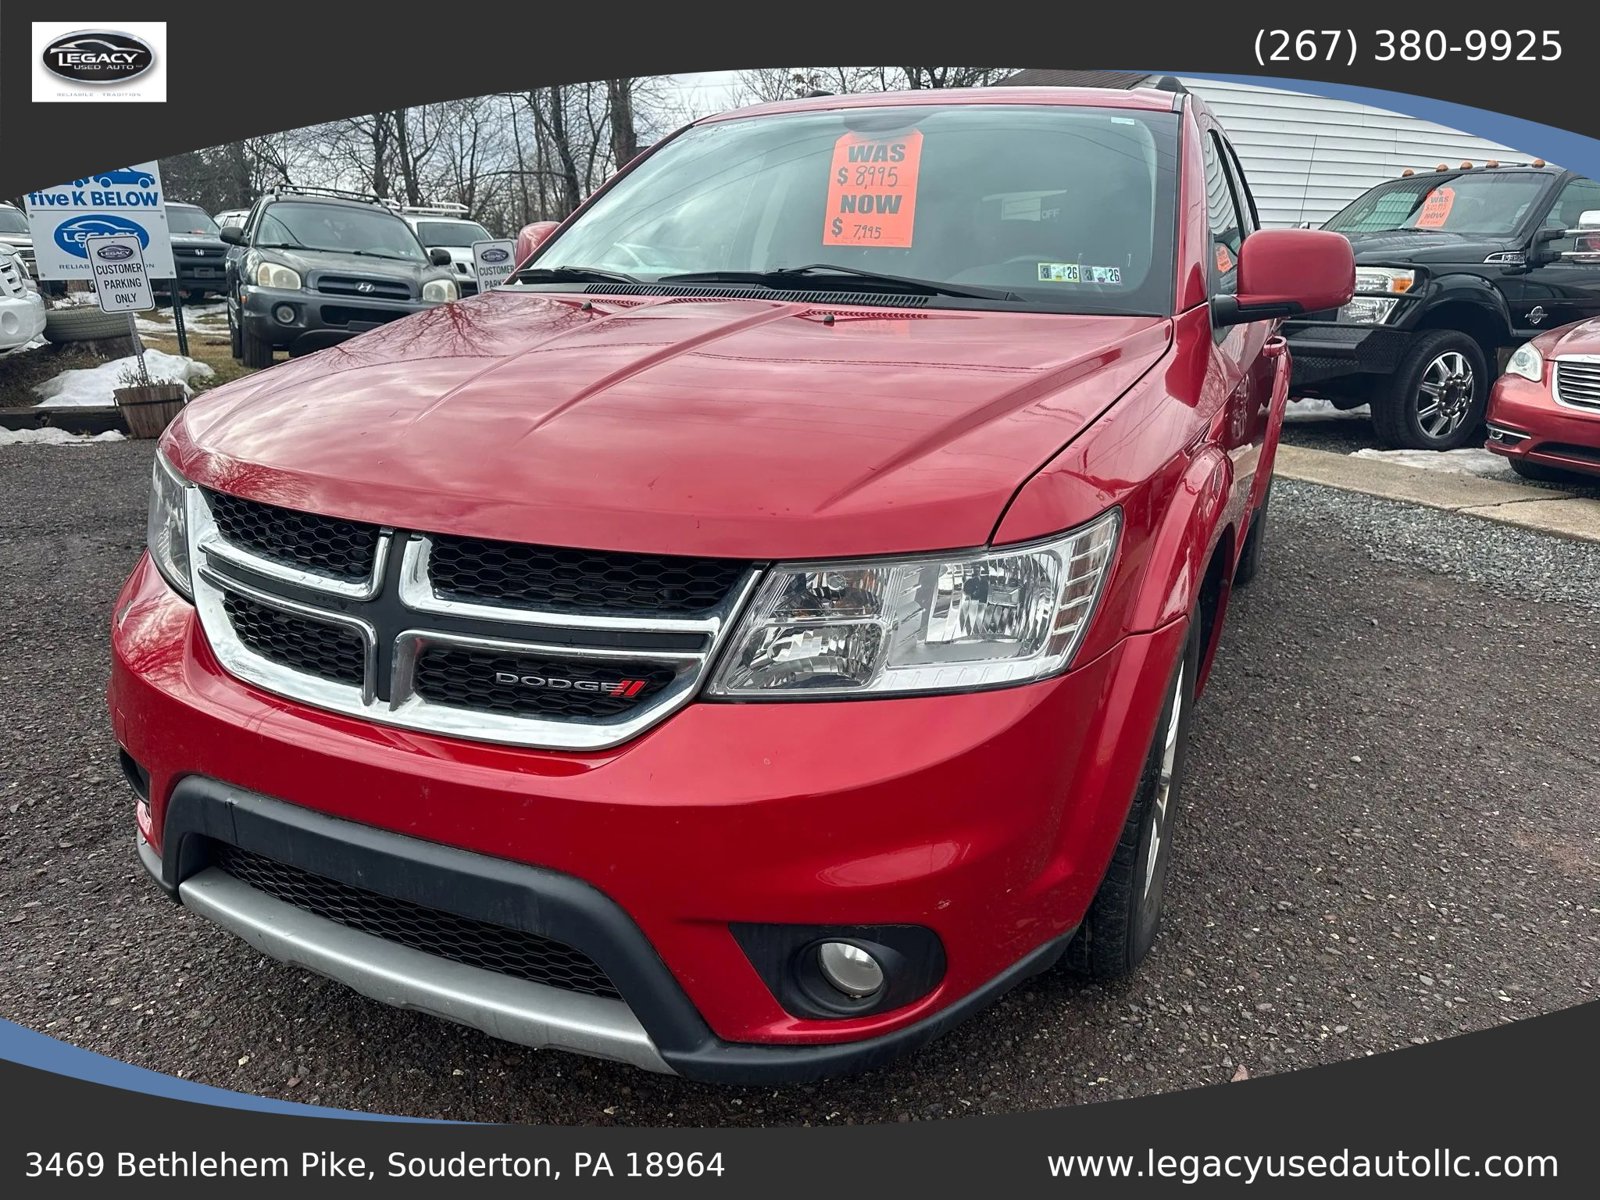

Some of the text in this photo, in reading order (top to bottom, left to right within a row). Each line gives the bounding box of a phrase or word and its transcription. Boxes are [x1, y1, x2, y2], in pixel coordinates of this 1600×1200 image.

[848, 143, 905, 162] WAS
[28, 190, 158, 206] five K BELOW
[840, 194, 902, 214] NOW
[96, 263, 143, 275] CUSTOMER
[479, 265, 515, 276] CUSTOMER
[1067, 266, 1078, 279] 26
[1108, 268, 1120, 282] 26
[103, 278, 142, 290] PARKING
[115, 293, 137, 303] ONLY
[496, 672, 625, 693] DODGE
